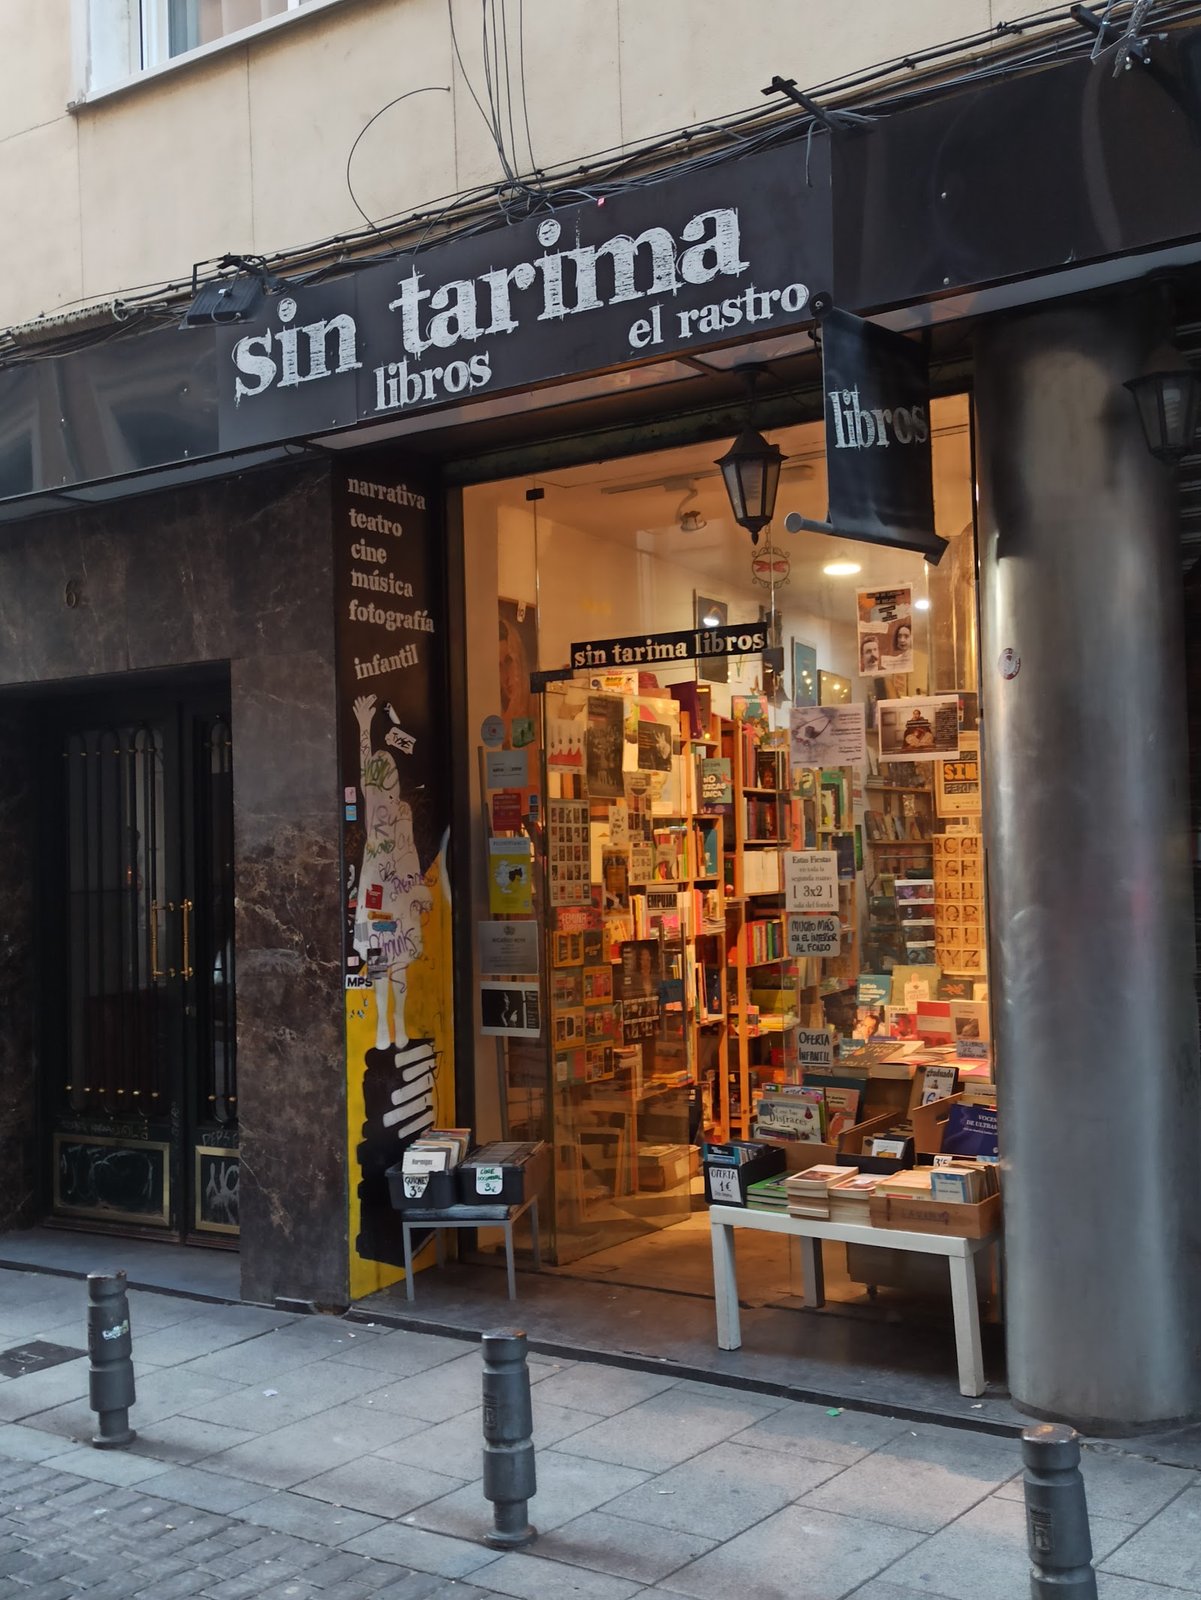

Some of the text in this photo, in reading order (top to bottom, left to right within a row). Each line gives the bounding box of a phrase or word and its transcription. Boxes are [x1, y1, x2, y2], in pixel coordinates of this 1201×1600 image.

[233, 205, 752, 407] sin tarima
[629, 282, 811, 350] el rastro
[374, 350, 493, 413] libros
[829, 384, 929, 450] libros
[348, 476, 426, 511] narrativa
[349, 508, 403, 538] teatro
[351, 538, 387, 565] cine
[351, 569, 414, 598] música
[349, 598, 435, 634] fotografía
[354, 643, 419, 680] infantil
[574, 631, 765, 668] sin tarima libros
[803, 884, 823, 897] 3x2
[347, 976, 373, 988] MPS
[798, 1031, 830, 1046] OFERTA
